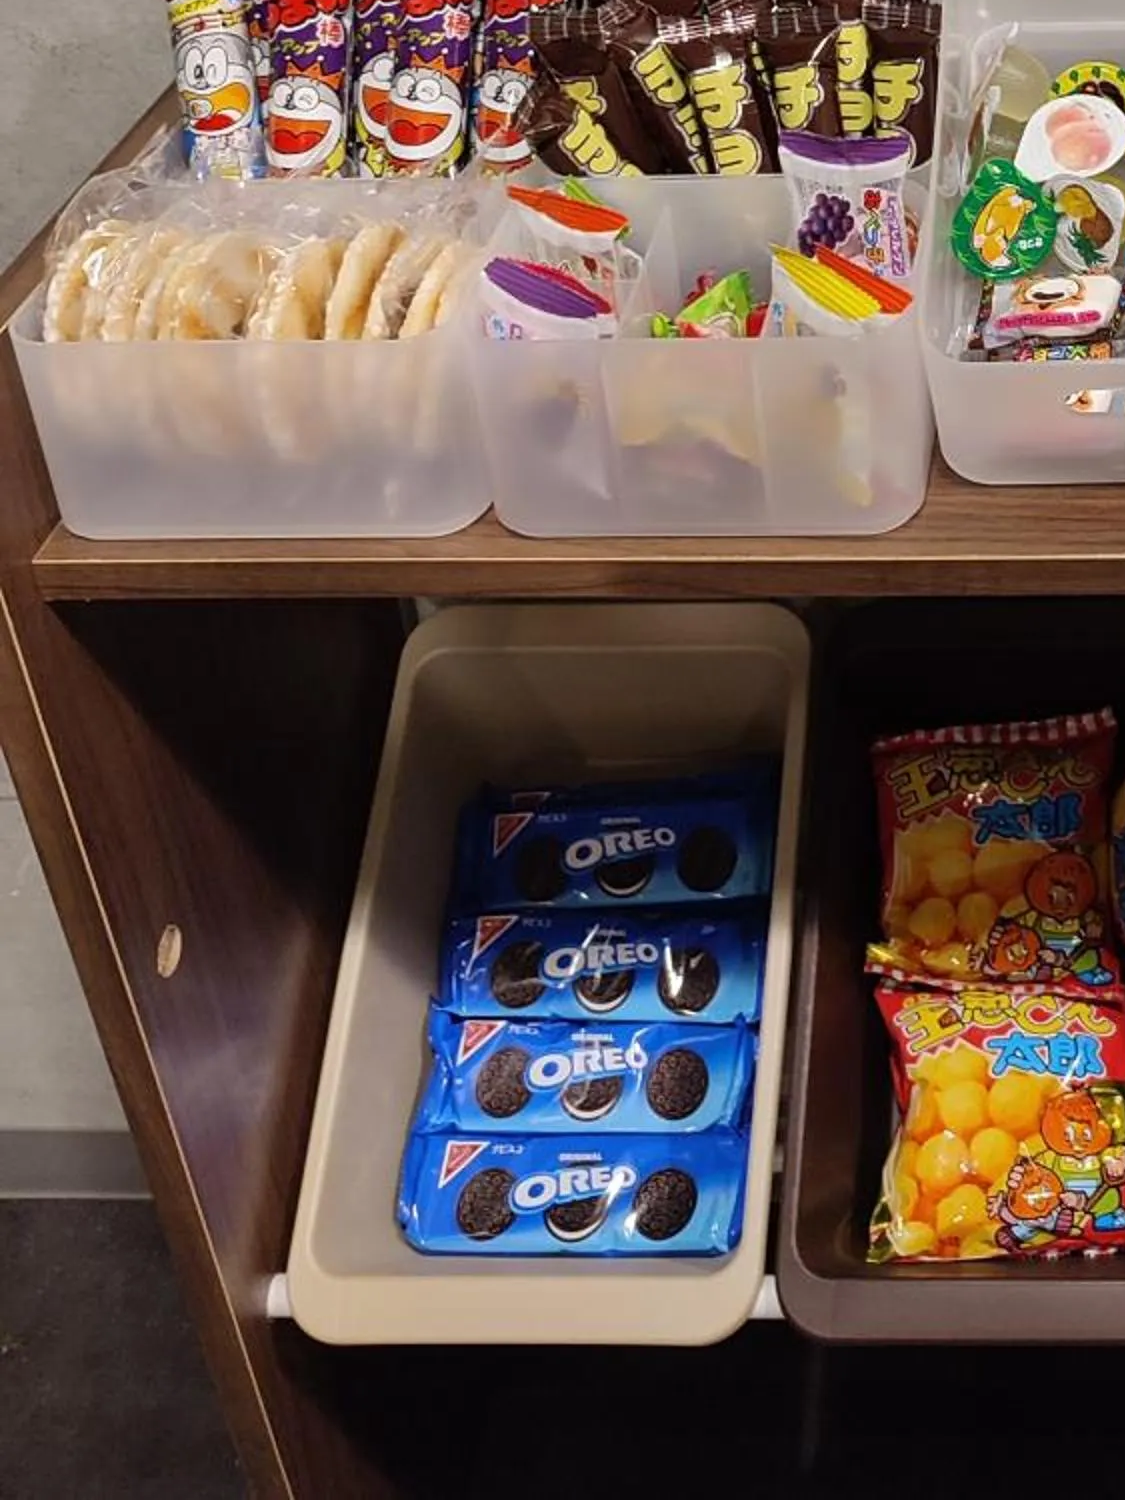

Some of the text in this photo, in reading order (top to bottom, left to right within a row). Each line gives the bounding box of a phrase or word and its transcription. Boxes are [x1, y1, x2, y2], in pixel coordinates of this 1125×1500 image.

[565, 826, 676, 870] OREO
[543, 942, 659, 979] OREO
[529, 1046, 648, 1088] OREO
[513, 1164, 637, 1209] OREO
